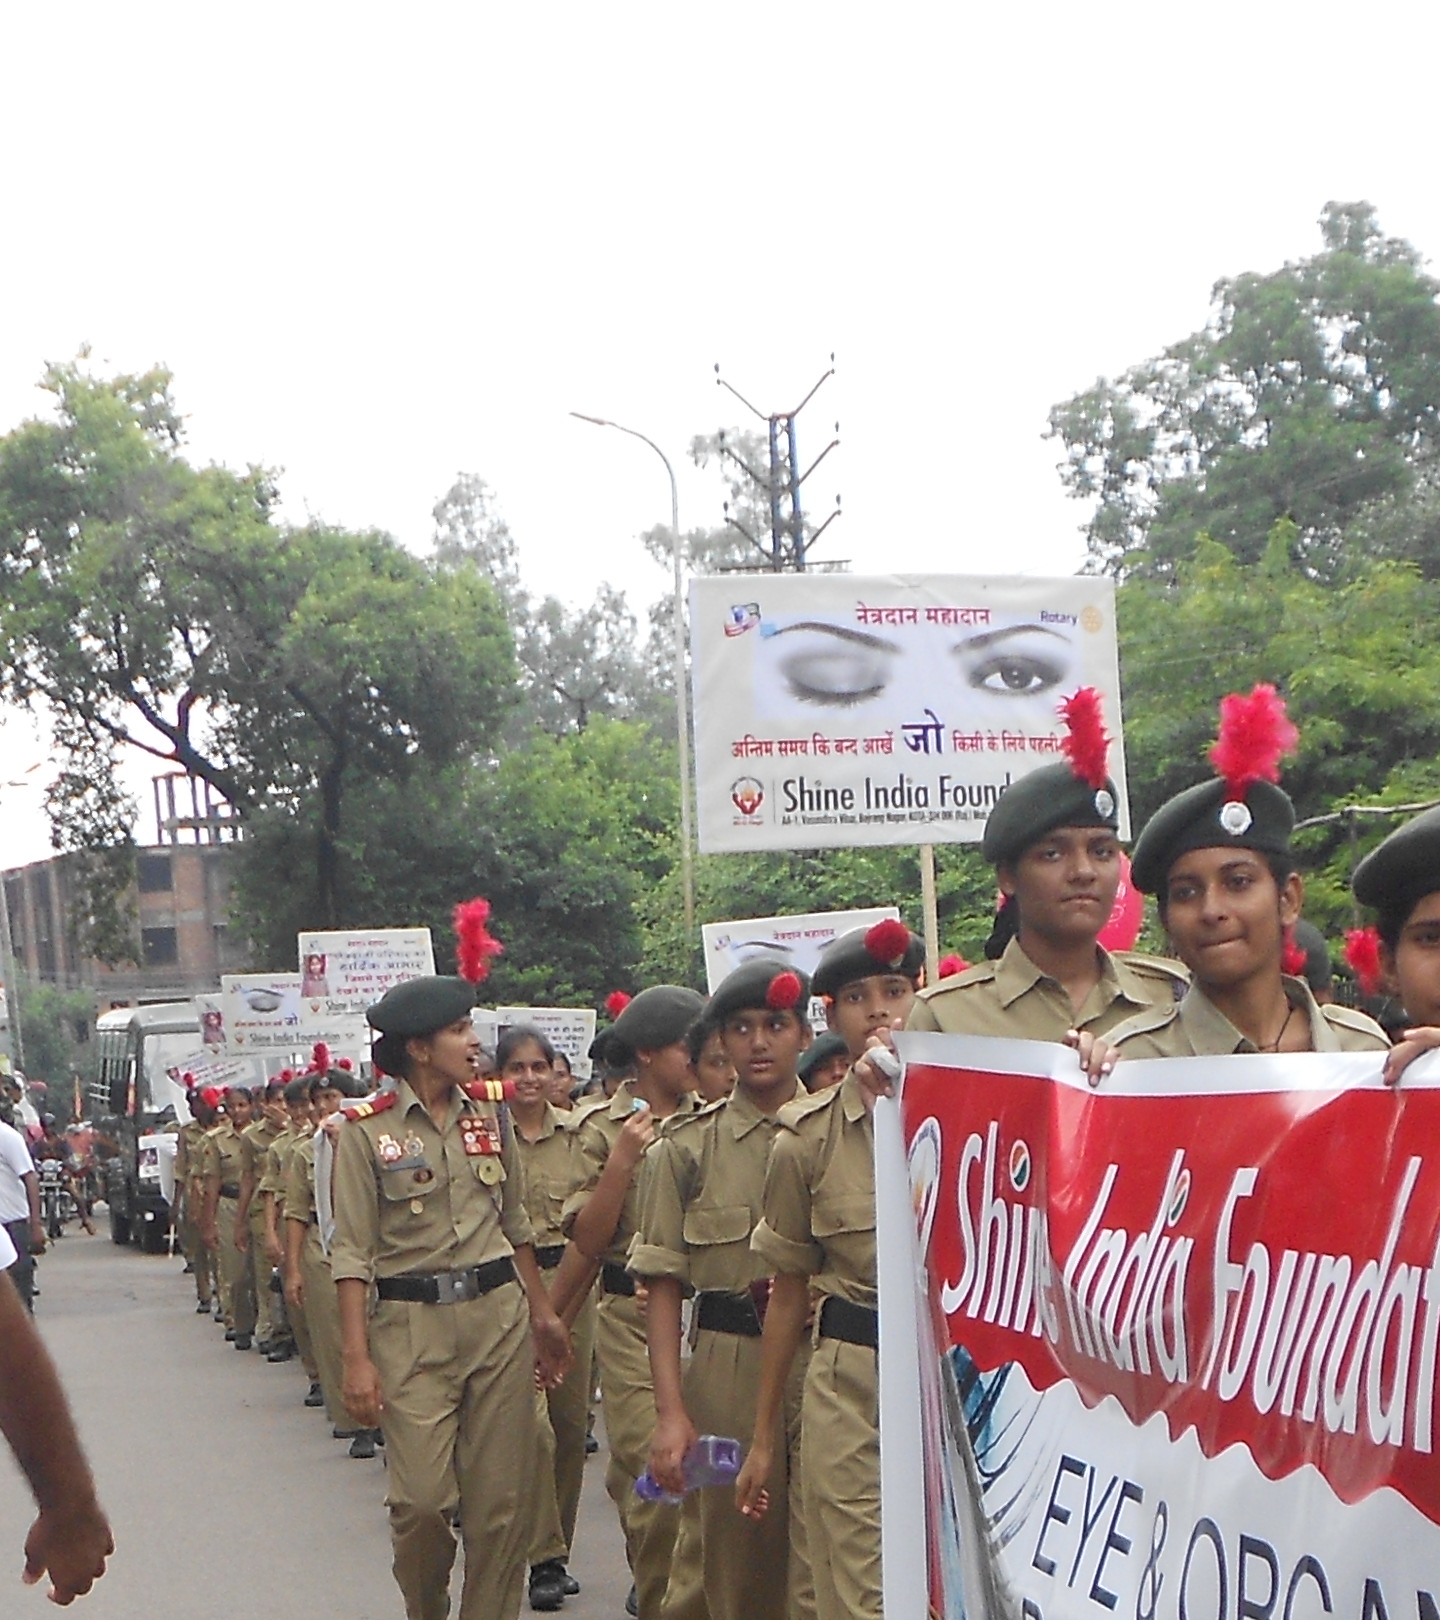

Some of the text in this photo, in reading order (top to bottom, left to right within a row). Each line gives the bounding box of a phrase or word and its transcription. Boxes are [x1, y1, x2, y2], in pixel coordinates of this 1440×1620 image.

[856, 600, 992, 626] नेत्रदान महादान
[1040, 610, 1078, 627] Rotary
[777, 739, 809, 757] समय
[901, 708, 945, 755] जो
[953, 730, 984, 752] किसी
[782, 772, 1012, 813] Shine India Found
[941, 1120, 1059, 1344] Shine
[1063, 1148, 1194, 1384] India
[1032, 1453, 1144, 1611] EYE
